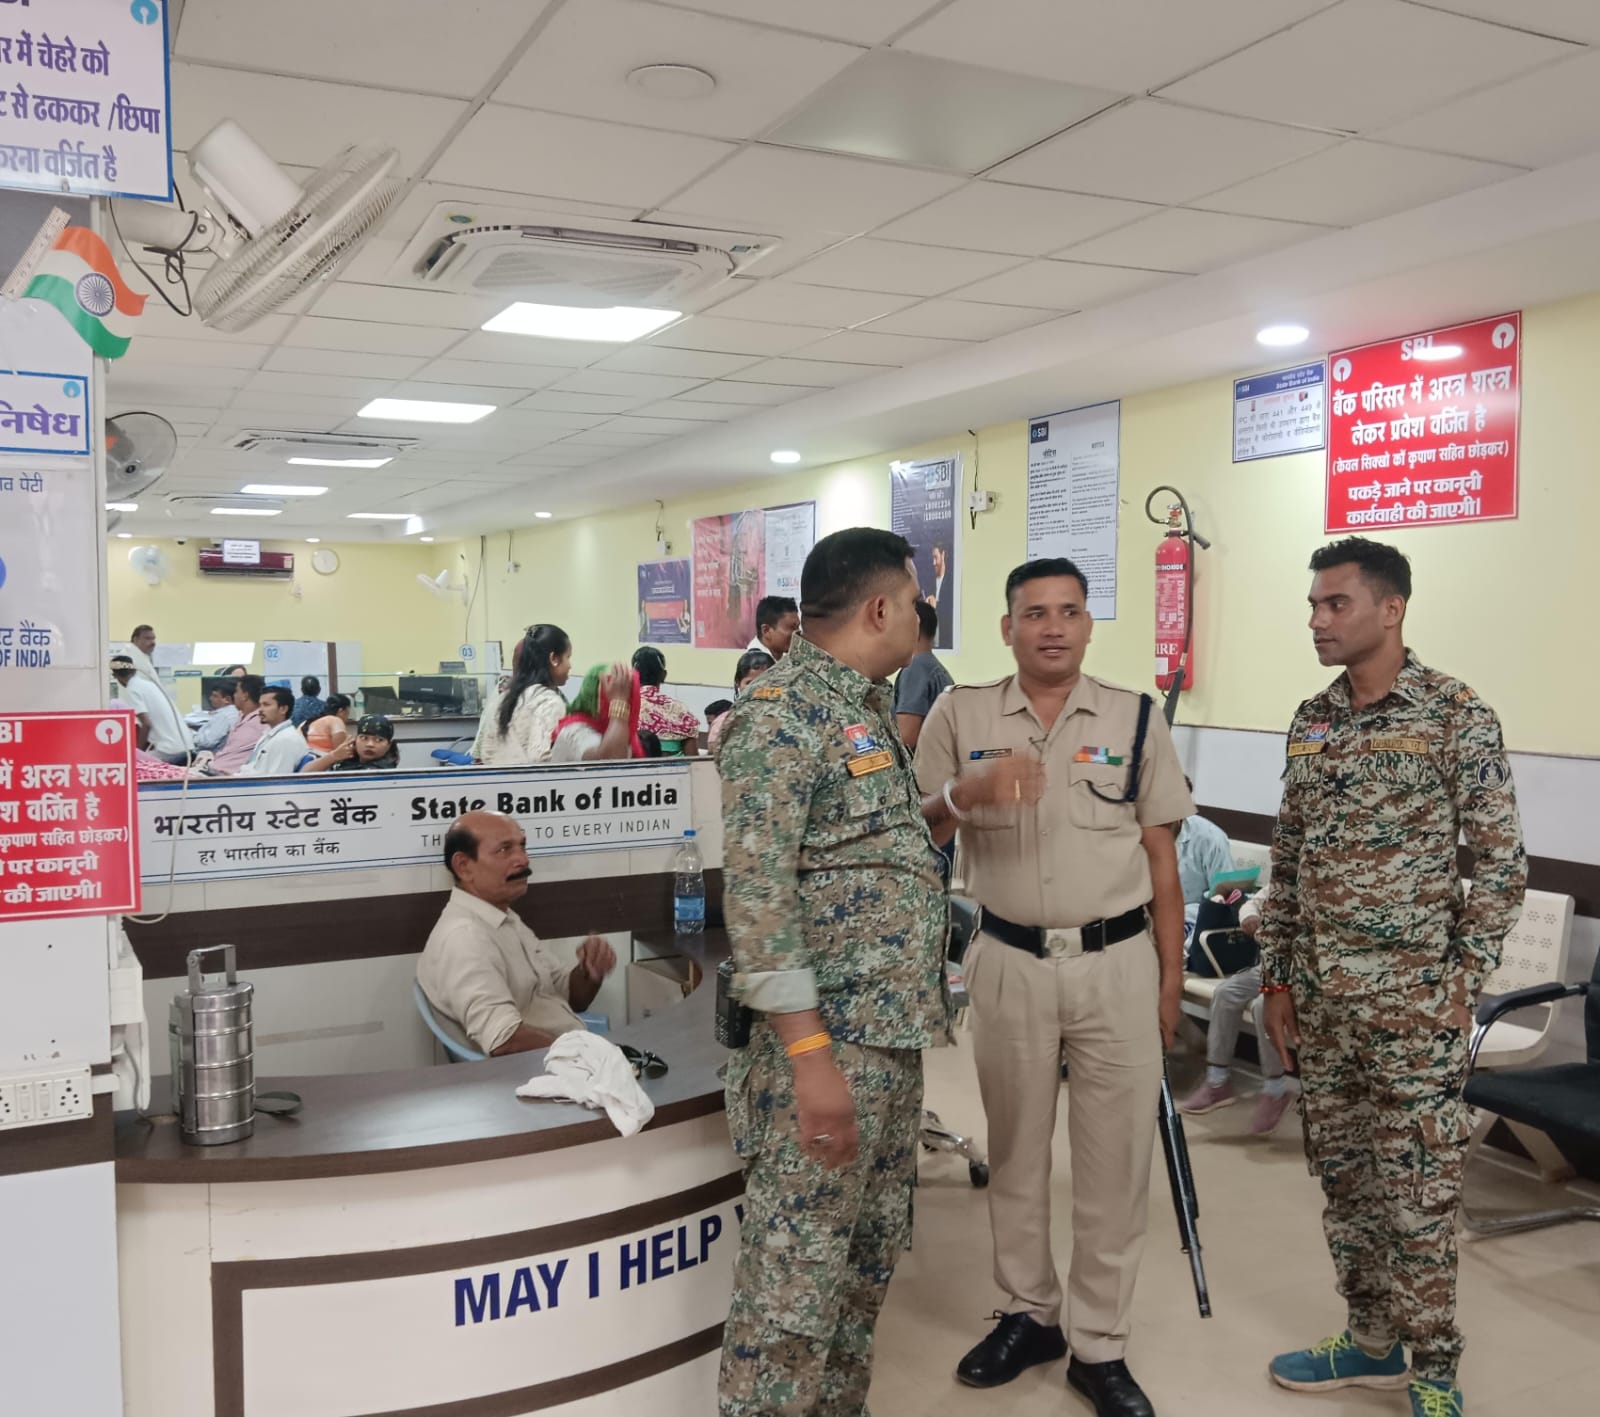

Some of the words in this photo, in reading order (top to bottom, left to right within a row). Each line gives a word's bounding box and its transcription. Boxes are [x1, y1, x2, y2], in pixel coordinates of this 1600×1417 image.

[16, 28, 33, 67] में
[37, 32, 77, 73] चेहरे
[80, 40, 110, 76] को
[10, 83, 29, 119] से
[32, 94, 100, 127] ढककर
[43, 139, 100, 180] वर्जित
[102, 145, 118, 182] है
[1332, 388, 1357, 417] बैंक
[1361, 381, 1407, 412] परिसर
[1410, 374, 1424, 403] में
[1428, 374, 1467, 401] अस्त्र
[1351, 418, 1386, 446] लेकर
[1390, 412, 1426, 441] प्रवेश
[1430, 405, 1469, 436] वर्जित
[1475, 402, 1487, 432] है
[1408, 449, 1437, 469] कृपाण
[1438, 442, 1466, 462] सहित
[19, 472, 43, 493] पेटी
[1348, 480, 1382, 502] पकड़े
[1383, 477, 1412, 498] जाने
[1413, 480, 1432, 495] पर
[1432, 469, 1483, 496] कानूनी
[1346, 502, 1405, 525] कार्यवाही
[1406, 500, 1428, 519] की
[19, 619, 51, 646] बैंक
[16, 648, 51, 668] INDIA
[266, 648, 279, 659] 02
[462, 647, 473, 657] 03
[1156, 643, 1178, 655] IRE
[21, 764, 71, 788] अस्त्र
[77, 762, 127, 786] शस्त्र
[25, 791, 78, 822] वर्जित
[84, 791, 101, 820] है
[411, 796, 486, 820] State
[497, 789, 565, 814] Bank
[575, 787, 602, 810] of
[612, 782, 678, 808] India
[154, 804, 256, 836] भारतीय
[266, 801, 321, 830] स्टेट
[331, 797, 378, 826] बैंक
[535, 826, 554, 840] TO
[562, 822, 612, 838] EVERY
[619, 818, 672, 833] INDIAN
[40, 827, 75, 846] सहित
[7, 859, 34, 875] पर
[35, 849, 99, 876] कानूनी
[198, 850, 216, 866] हर
[224, 842, 278, 862] भारतीय
[286, 843, 306, 857] का
[313, 838, 340, 856] बैंक
[3, 882, 33, 904] की
[455, 1259, 569, 1327] MAY
[588, 1251, 599, 1299] I
[620, 1214, 722, 1290] HELP
